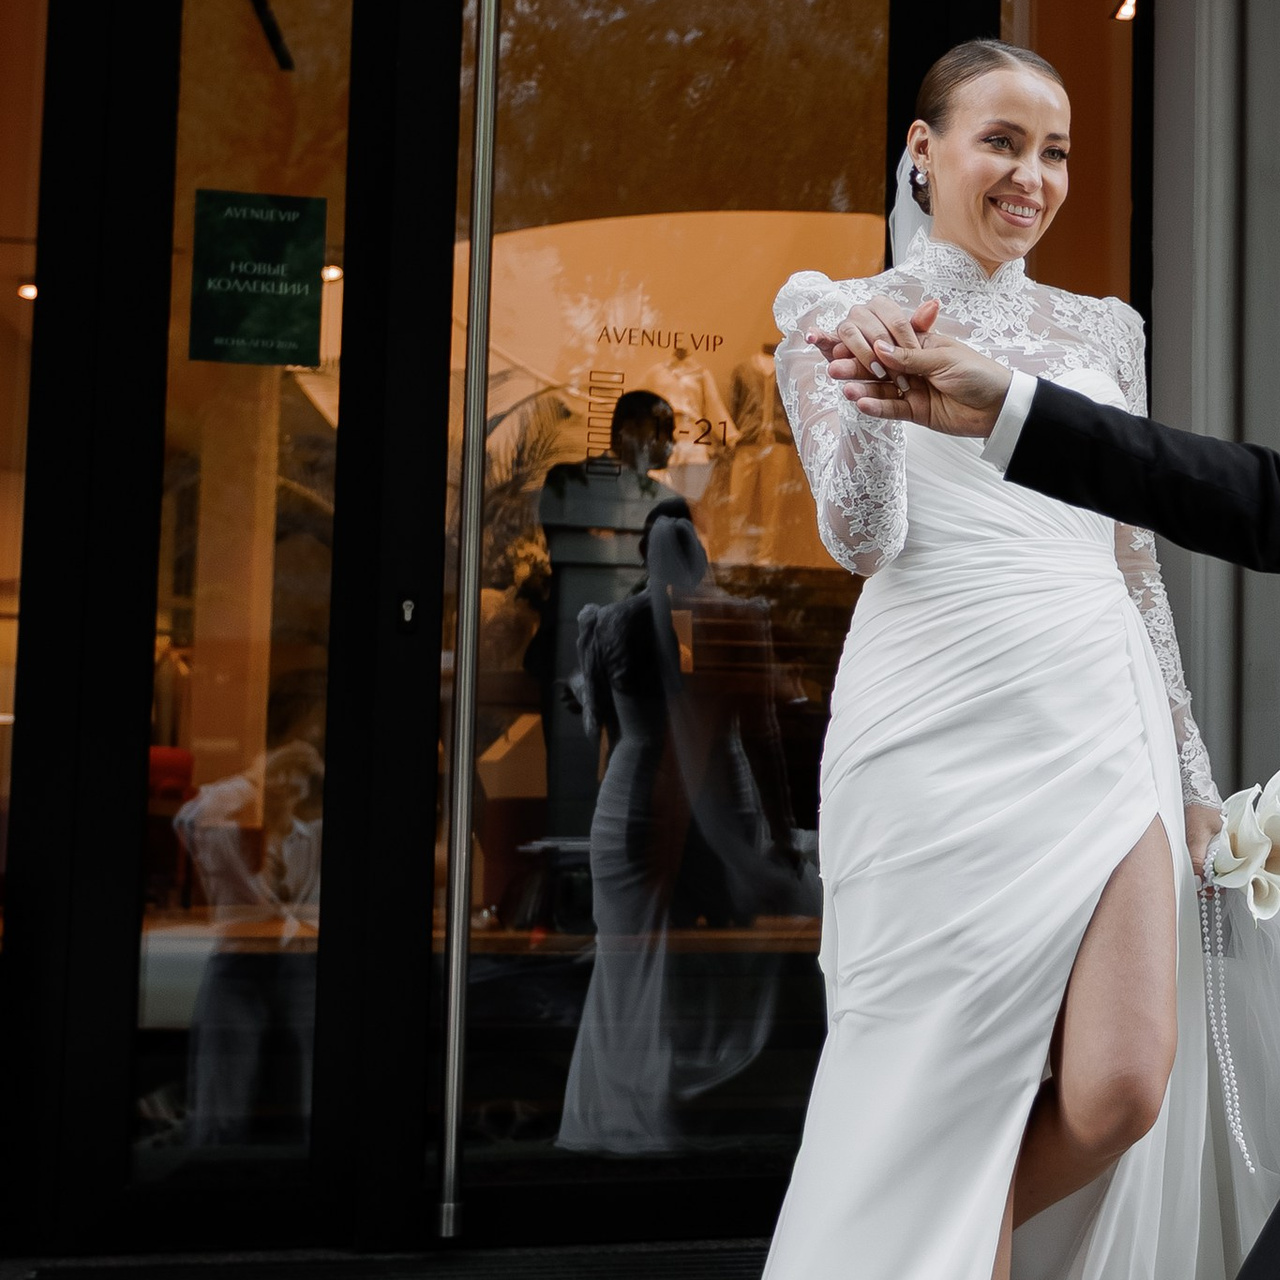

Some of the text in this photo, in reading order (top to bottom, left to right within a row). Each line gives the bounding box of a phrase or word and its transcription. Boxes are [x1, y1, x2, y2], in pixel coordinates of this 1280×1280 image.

[224, 206, 301, 222] AVENUE VIP
[230, 260, 288, 277] НОВЫЕ
[207, 277, 310, 296] КОЛЛЕКЦИИ
[597, 326, 724, 352] AVENUE VIP
